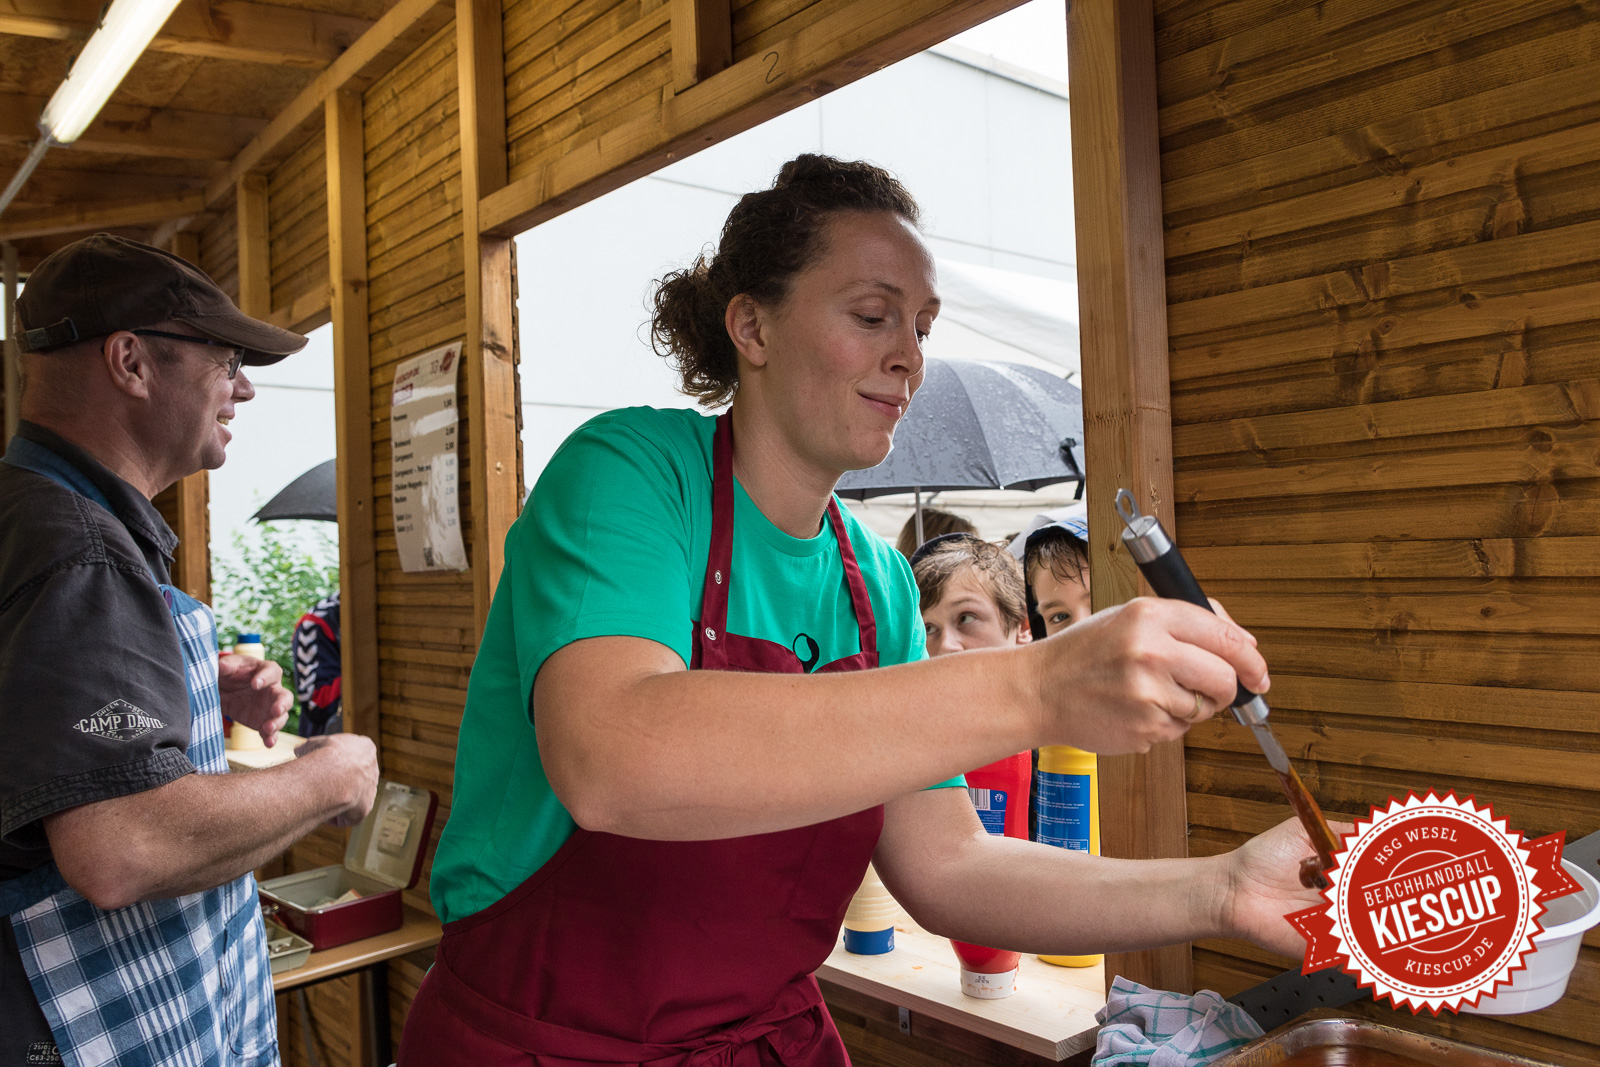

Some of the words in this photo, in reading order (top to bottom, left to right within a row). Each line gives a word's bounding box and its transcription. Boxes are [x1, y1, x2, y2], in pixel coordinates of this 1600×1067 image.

[763, 51, 786, 84] 2
[96, 702, 119, 717] GREEN
[79, 715, 122, 733] CAMP
[127, 714, 164, 729] DAVID
